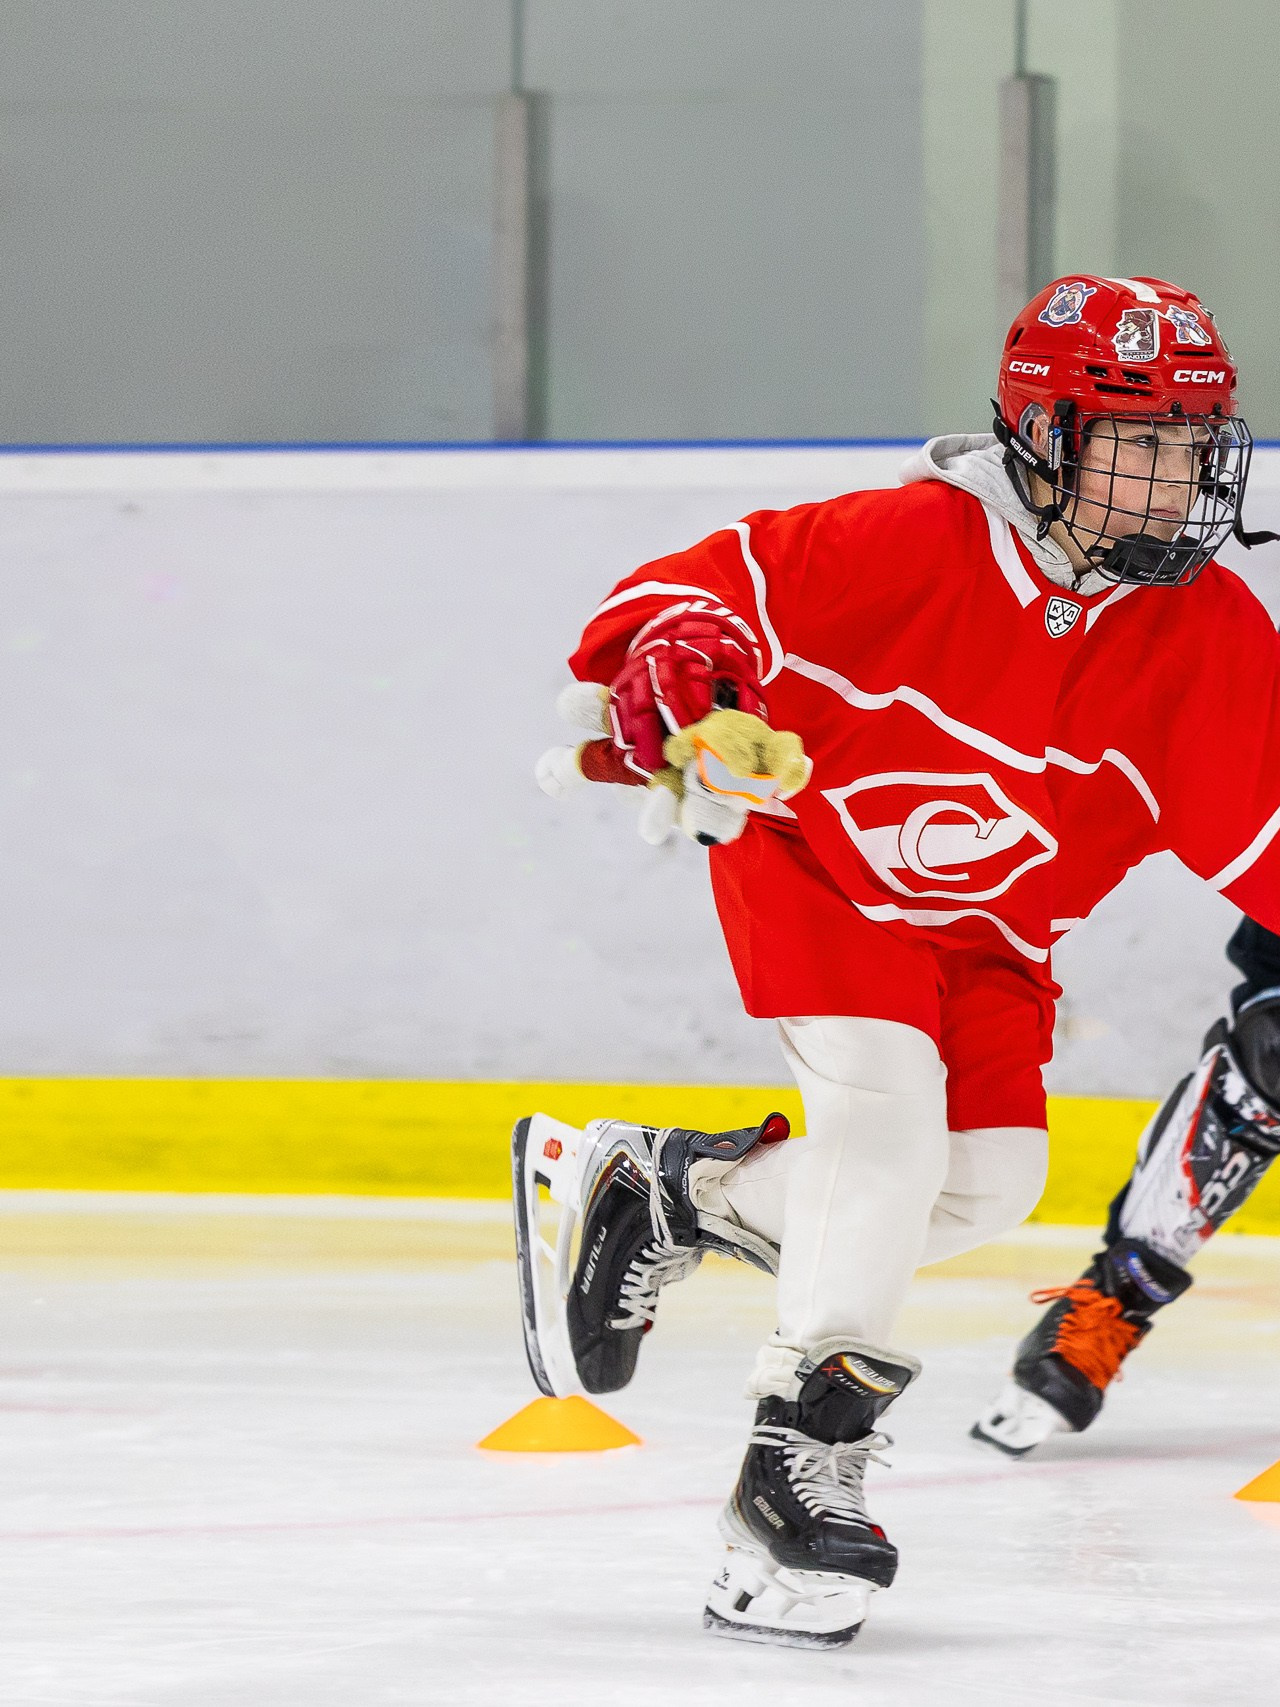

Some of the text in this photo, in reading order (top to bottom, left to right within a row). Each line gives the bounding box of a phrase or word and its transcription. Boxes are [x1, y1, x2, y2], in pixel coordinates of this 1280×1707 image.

[1009, 360, 1050, 376] CCM
[1173, 370, 1226, 384] CCM
[1010, 437, 1038, 466] BAUER
[753, 1495, 785, 1530] BAUER
